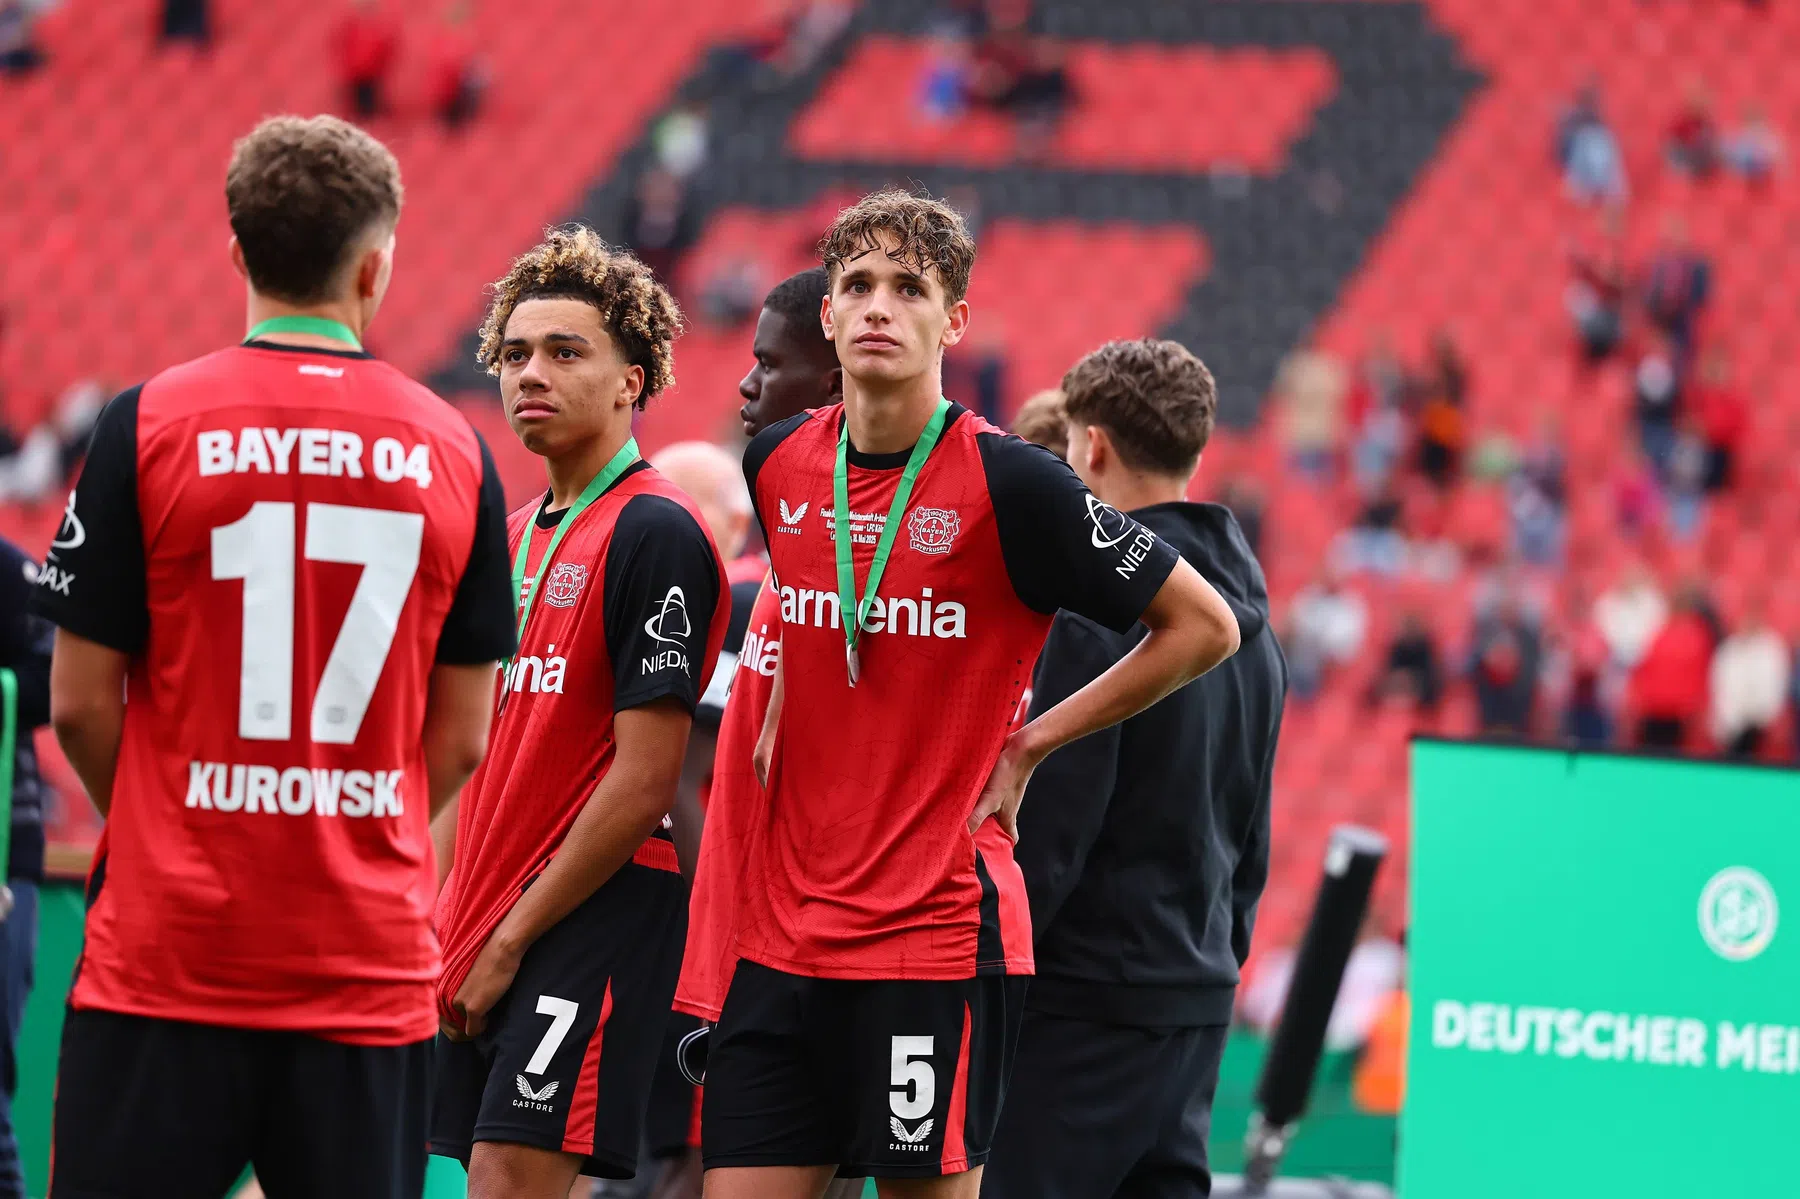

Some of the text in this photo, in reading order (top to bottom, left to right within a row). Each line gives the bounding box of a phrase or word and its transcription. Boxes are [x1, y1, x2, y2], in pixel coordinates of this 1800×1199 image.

[198, 427, 433, 489] BAYER 04
[777, 526, 802, 535] CASTORE
[210, 501, 425, 745] 17
[525, 995, 579, 1075] 7
[1432, 999, 1708, 1067] DEUTSCHER
[512, 1099, 554, 1113] CASTORE
[889, 1035, 936, 1119] 5
[889, 1143, 930, 1152] CASTORE
